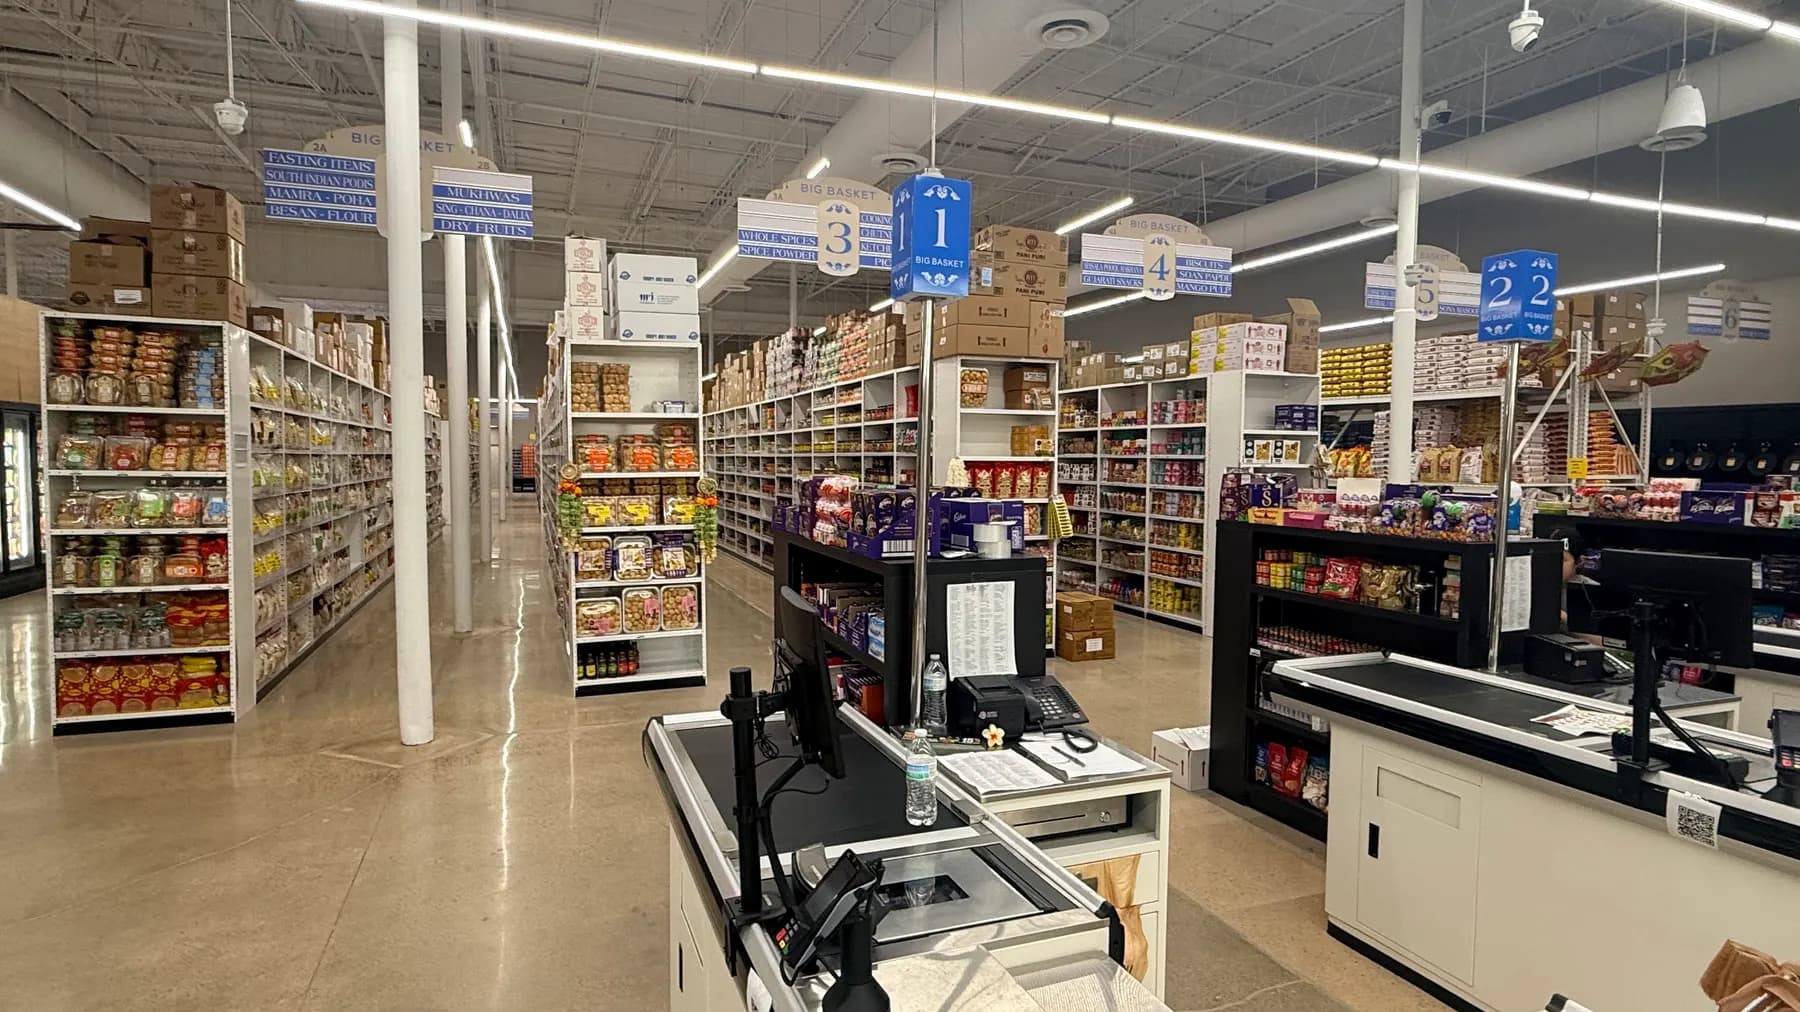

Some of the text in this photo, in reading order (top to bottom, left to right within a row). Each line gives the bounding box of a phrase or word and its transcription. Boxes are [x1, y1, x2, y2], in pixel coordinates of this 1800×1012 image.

[352, 132, 381, 146] BIG
[313, 143, 328, 152] 2A
[269, 151, 371, 172] FASTING ITEMS
[266, 169, 373, 189] SOUTH INDIAN PODIS
[269, 187, 322, 201] MAMRA
[333, 193, 372, 206] POHA
[447, 187, 520, 203] MUKHWAS
[801, 183, 877, 201] BIG BASKET
[270, 205, 317, 218] BESAN
[328, 210, 373, 223] FLOUR
[464, 205, 496, 217] CHANA
[503, 210, 530, 221] DALIA
[441, 219, 527, 236] DRY FRUITS
[933, 208, 949, 248] 1
[1130, 219, 1189, 233] BIG BASKET
[741, 230, 816, 245] WHOLE SPICES
[825, 221, 852, 254] 3
[741, 246, 816, 260] SPICE POWDER
[1016, 251, 1031, 259] PANI
[915, 255, 930, 265] BIG
[931, 257, 964, 269] BASKET
[1148, 253, 1170, 281] 4
[1185, 258, 1224, 269] BISCUITS
[1083, 275, 1143, 288] GUJARATI SNACKS
[1180, 270, 1229, 282] SOAN PAPDI
[1176, 282, 1232, 294] MANGO PULP
[1418, 279, 1434, 304] 5
[1488, 276, 1513, 309] 2
[1530, 274, 1551, 307] 2
[1725, 308, 1737, 329] 6
